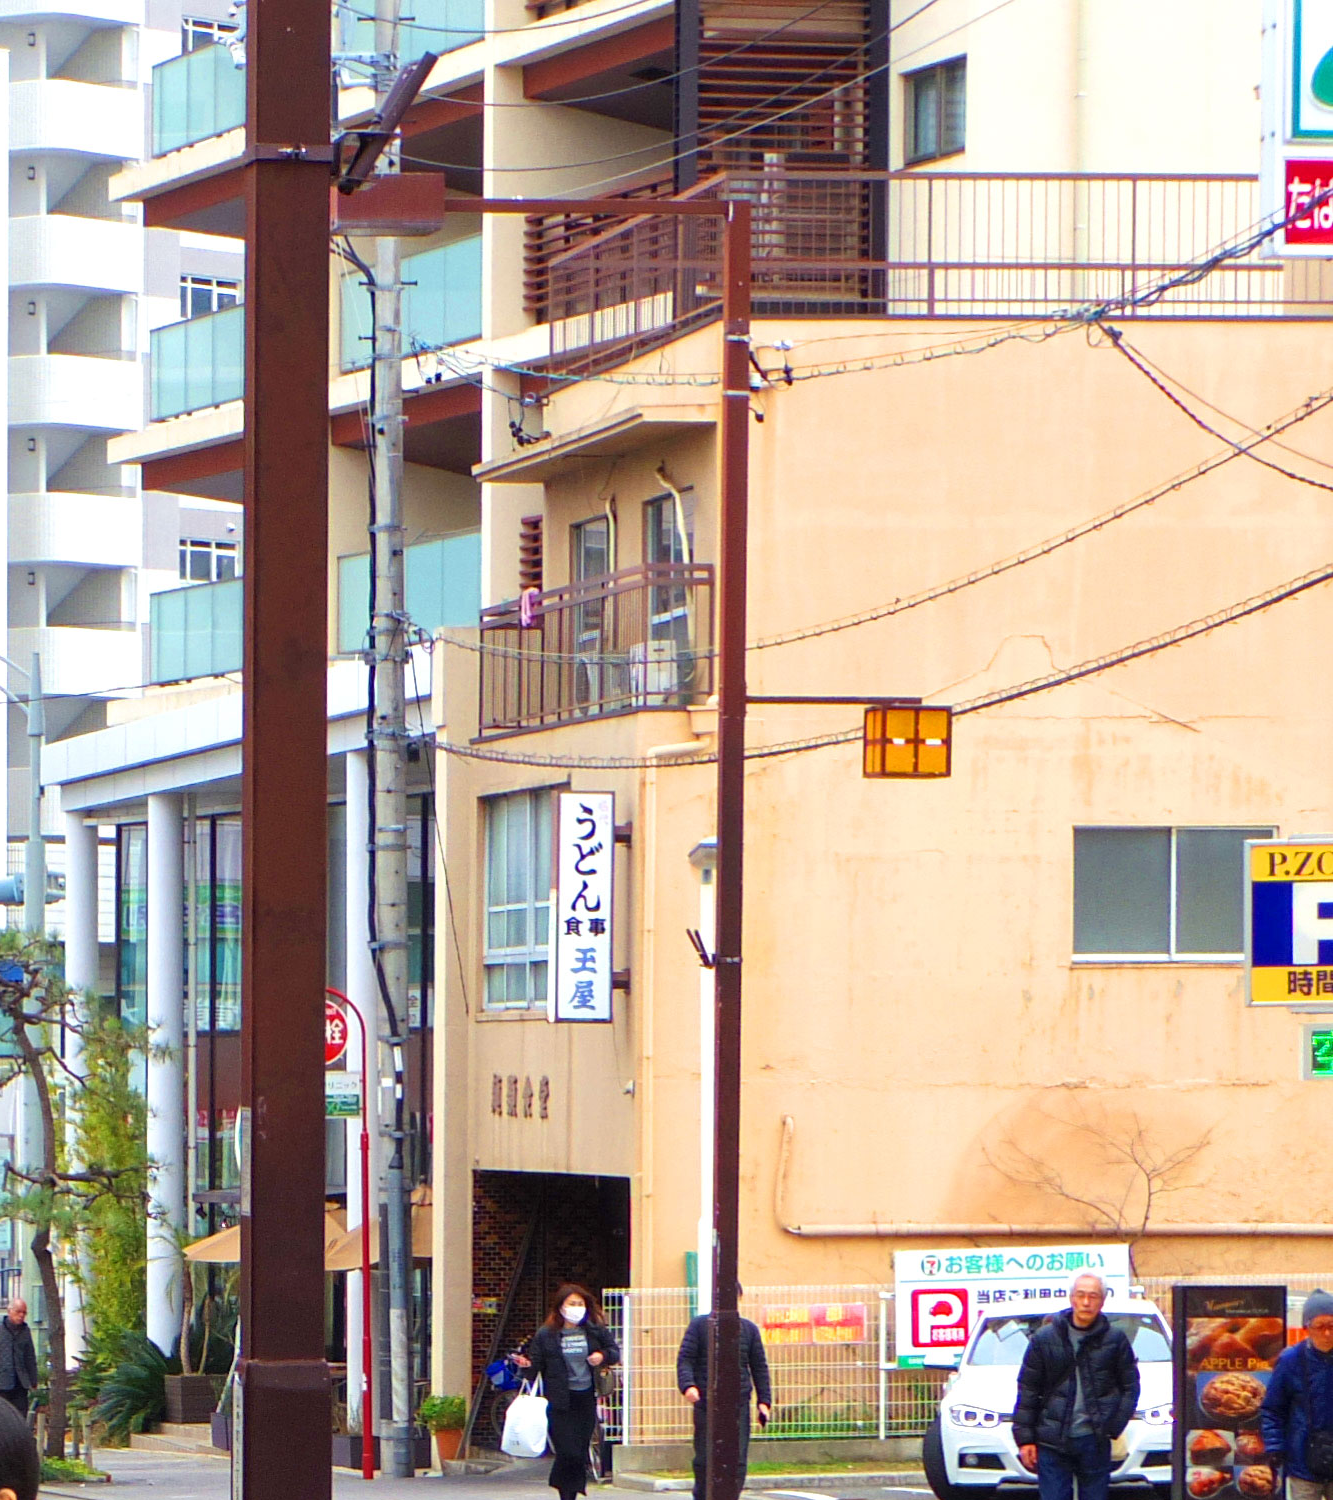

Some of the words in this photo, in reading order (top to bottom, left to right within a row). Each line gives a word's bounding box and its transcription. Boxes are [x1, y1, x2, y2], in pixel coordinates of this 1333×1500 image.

[571, 802, 603, 912] うどん
[564, 917, 606, 937] 食事
[945, 1252, 1105, 1274] お客様へのお願い
